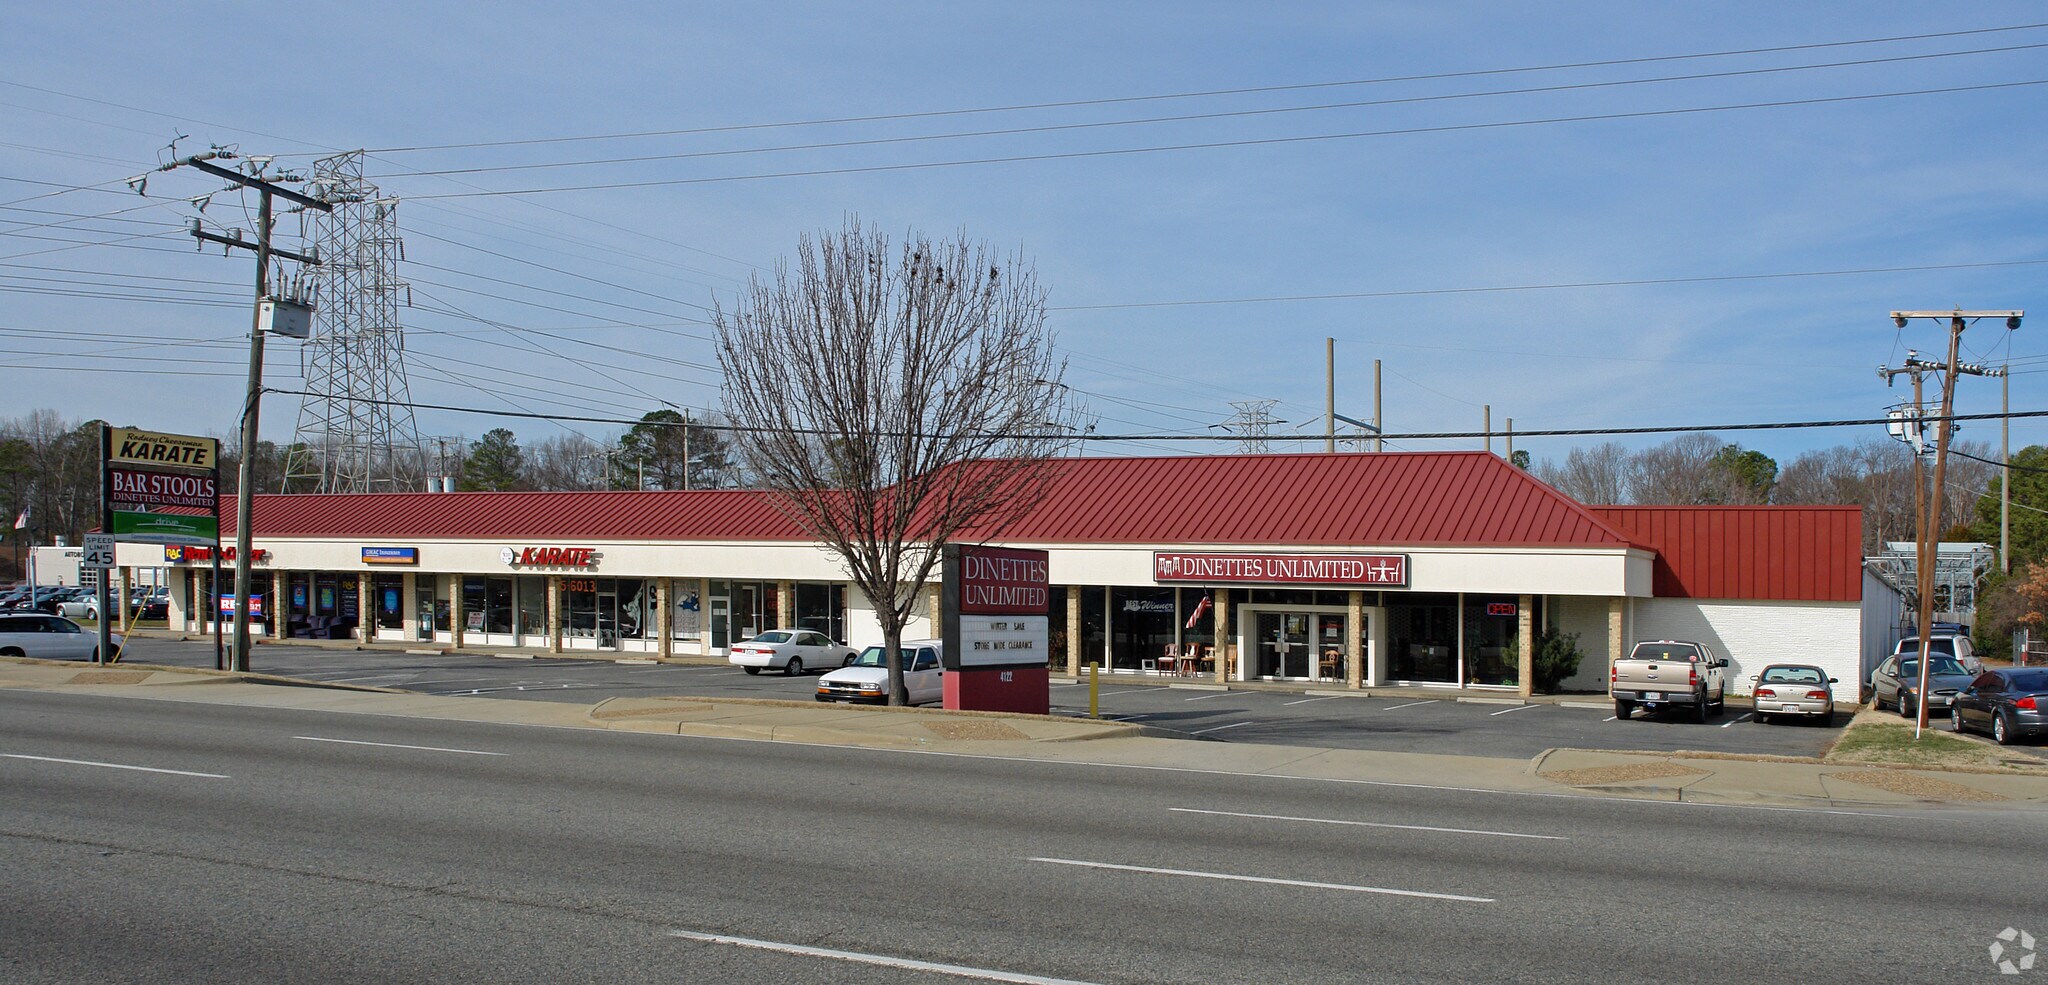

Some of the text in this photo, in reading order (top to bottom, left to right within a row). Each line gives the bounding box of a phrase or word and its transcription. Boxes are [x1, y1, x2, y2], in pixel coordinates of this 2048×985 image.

[127, 433, 203, 447] Rodney Cheeseman
[120, 441, 208, 464] KARATE
[113, 472, 215, 497] BAR STOOLS
[113, 492, 215, 506] DINETTES UNLIMITED
[155, 517, 179, 525] drive
[86, 551, 114, 564] 45
[166, 548, 181, 560] RAC
[520, 547, 596, 566] KARATE
[965, 556, 1047, 583] DINETTES
[1182, 557, 1365, 579] DINETTES UNLIMITED
[965, 585, 1046, 606] UNLIMITED
[1140, 600, 1174, 610] Winner
[1488, 603, 1515, 615] OPEN
[1014, 622, 1025, 630] SALE
[974, 641, 1032, 650] STORE WIDE CLEARANCE
[1000, 671, 1013, 682] 4122
